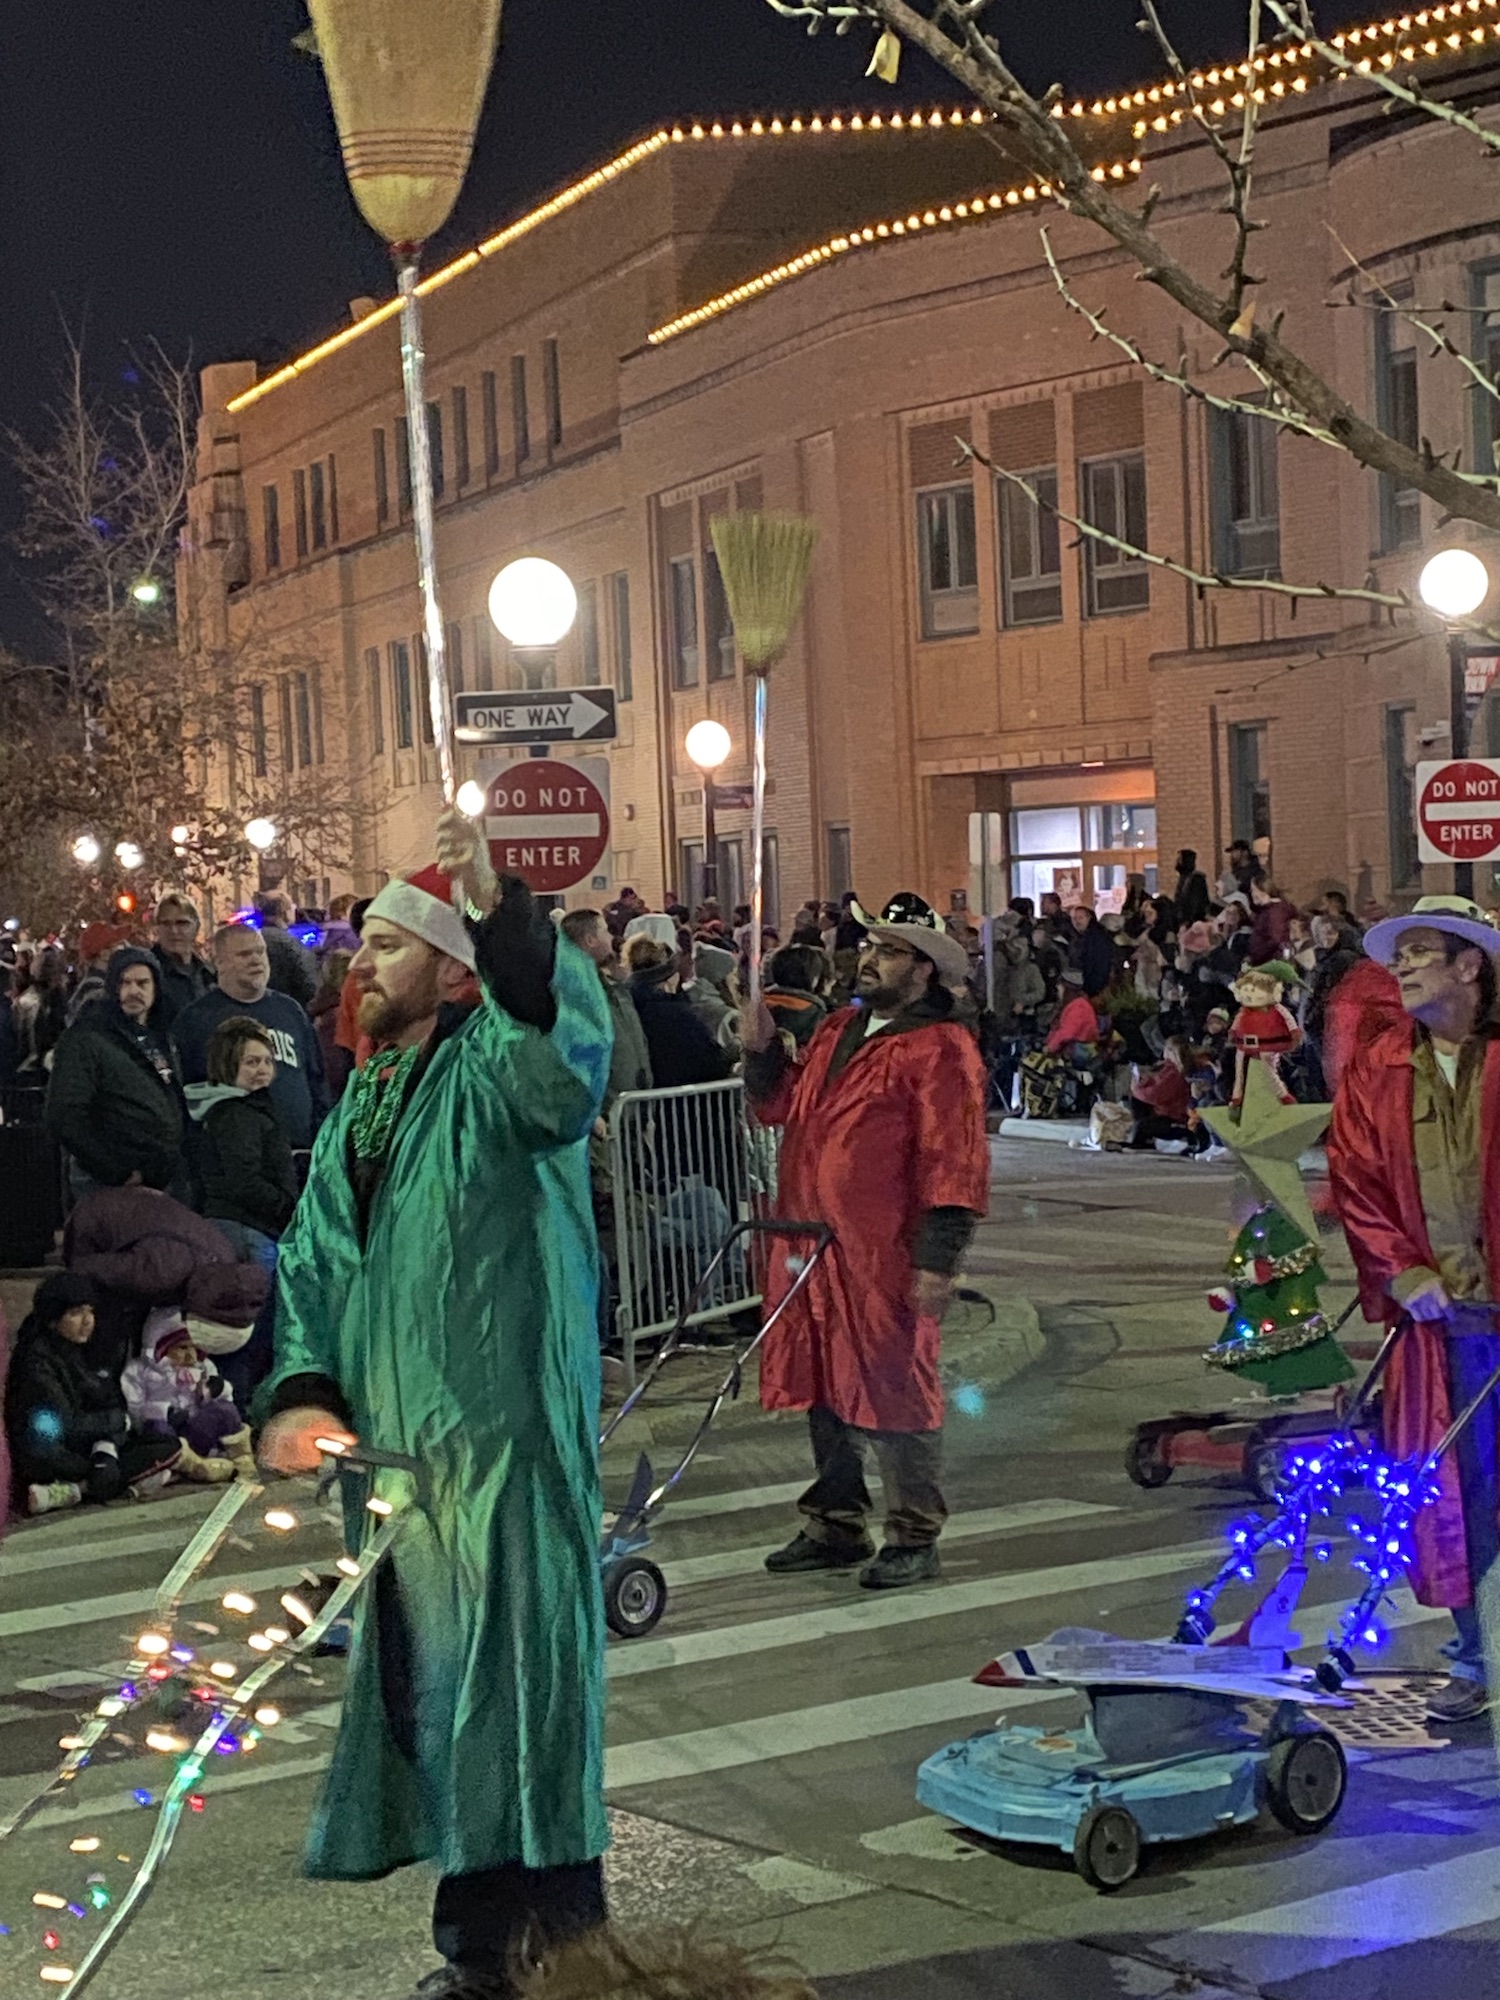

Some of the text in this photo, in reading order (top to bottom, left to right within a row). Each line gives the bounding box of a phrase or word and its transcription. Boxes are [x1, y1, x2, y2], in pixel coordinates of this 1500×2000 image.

[473, 706, 571, 728] ONE WAY
[495, 786, 587, 809] DO NOT
[1433, 779, 1498, 797] DO NOT
[1440, 824, 1493, 841] ENTER
[506, 846, 580, 867] ENTER
